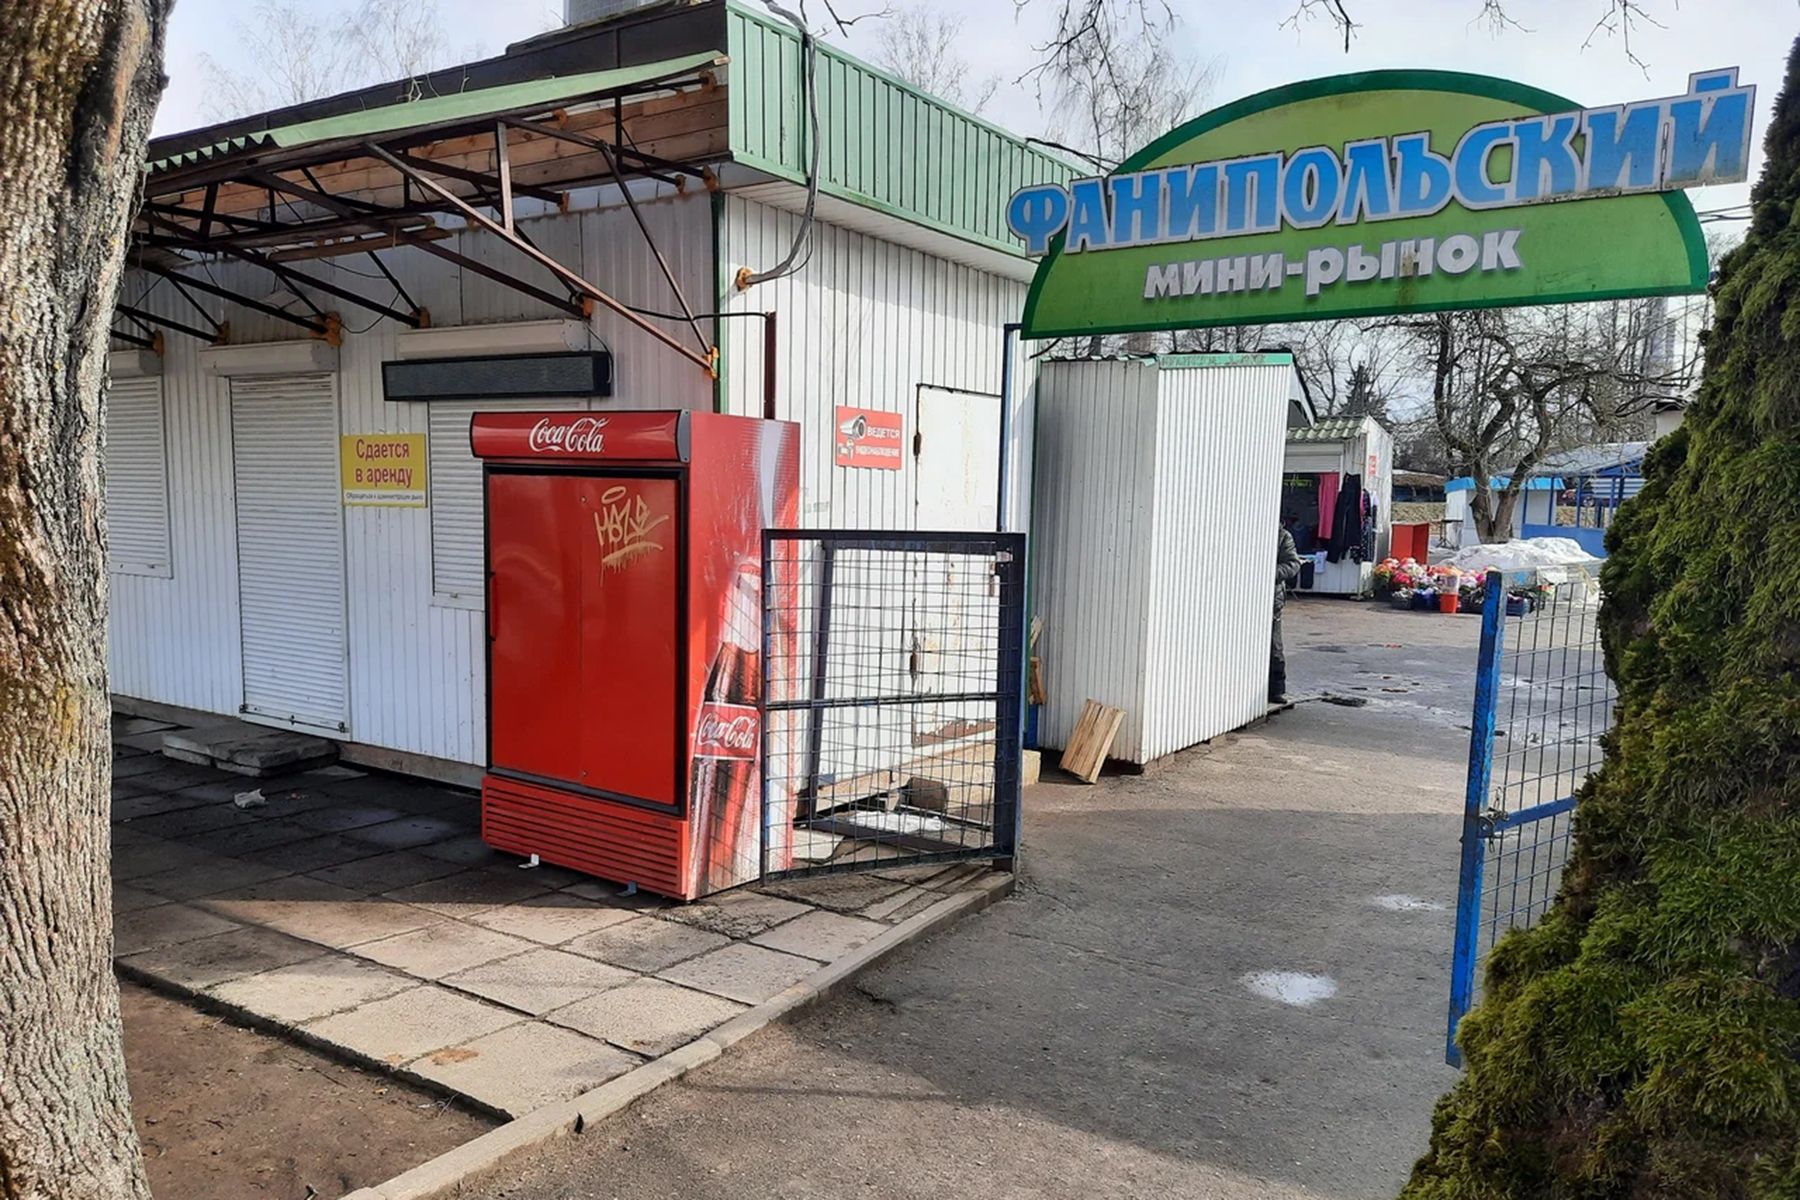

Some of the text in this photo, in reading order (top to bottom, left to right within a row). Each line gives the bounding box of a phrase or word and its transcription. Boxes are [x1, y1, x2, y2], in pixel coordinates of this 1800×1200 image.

[1007, 67, 1755, 256] ФАНИПОЛЬСКИЙ
[1143, 229, 1522, 298] мини-рынок
[356, 439, 410, 461] Сдается
[529, 417, 610, 452] Coca-Cola
[355, 468, 412, 488] в аренду
